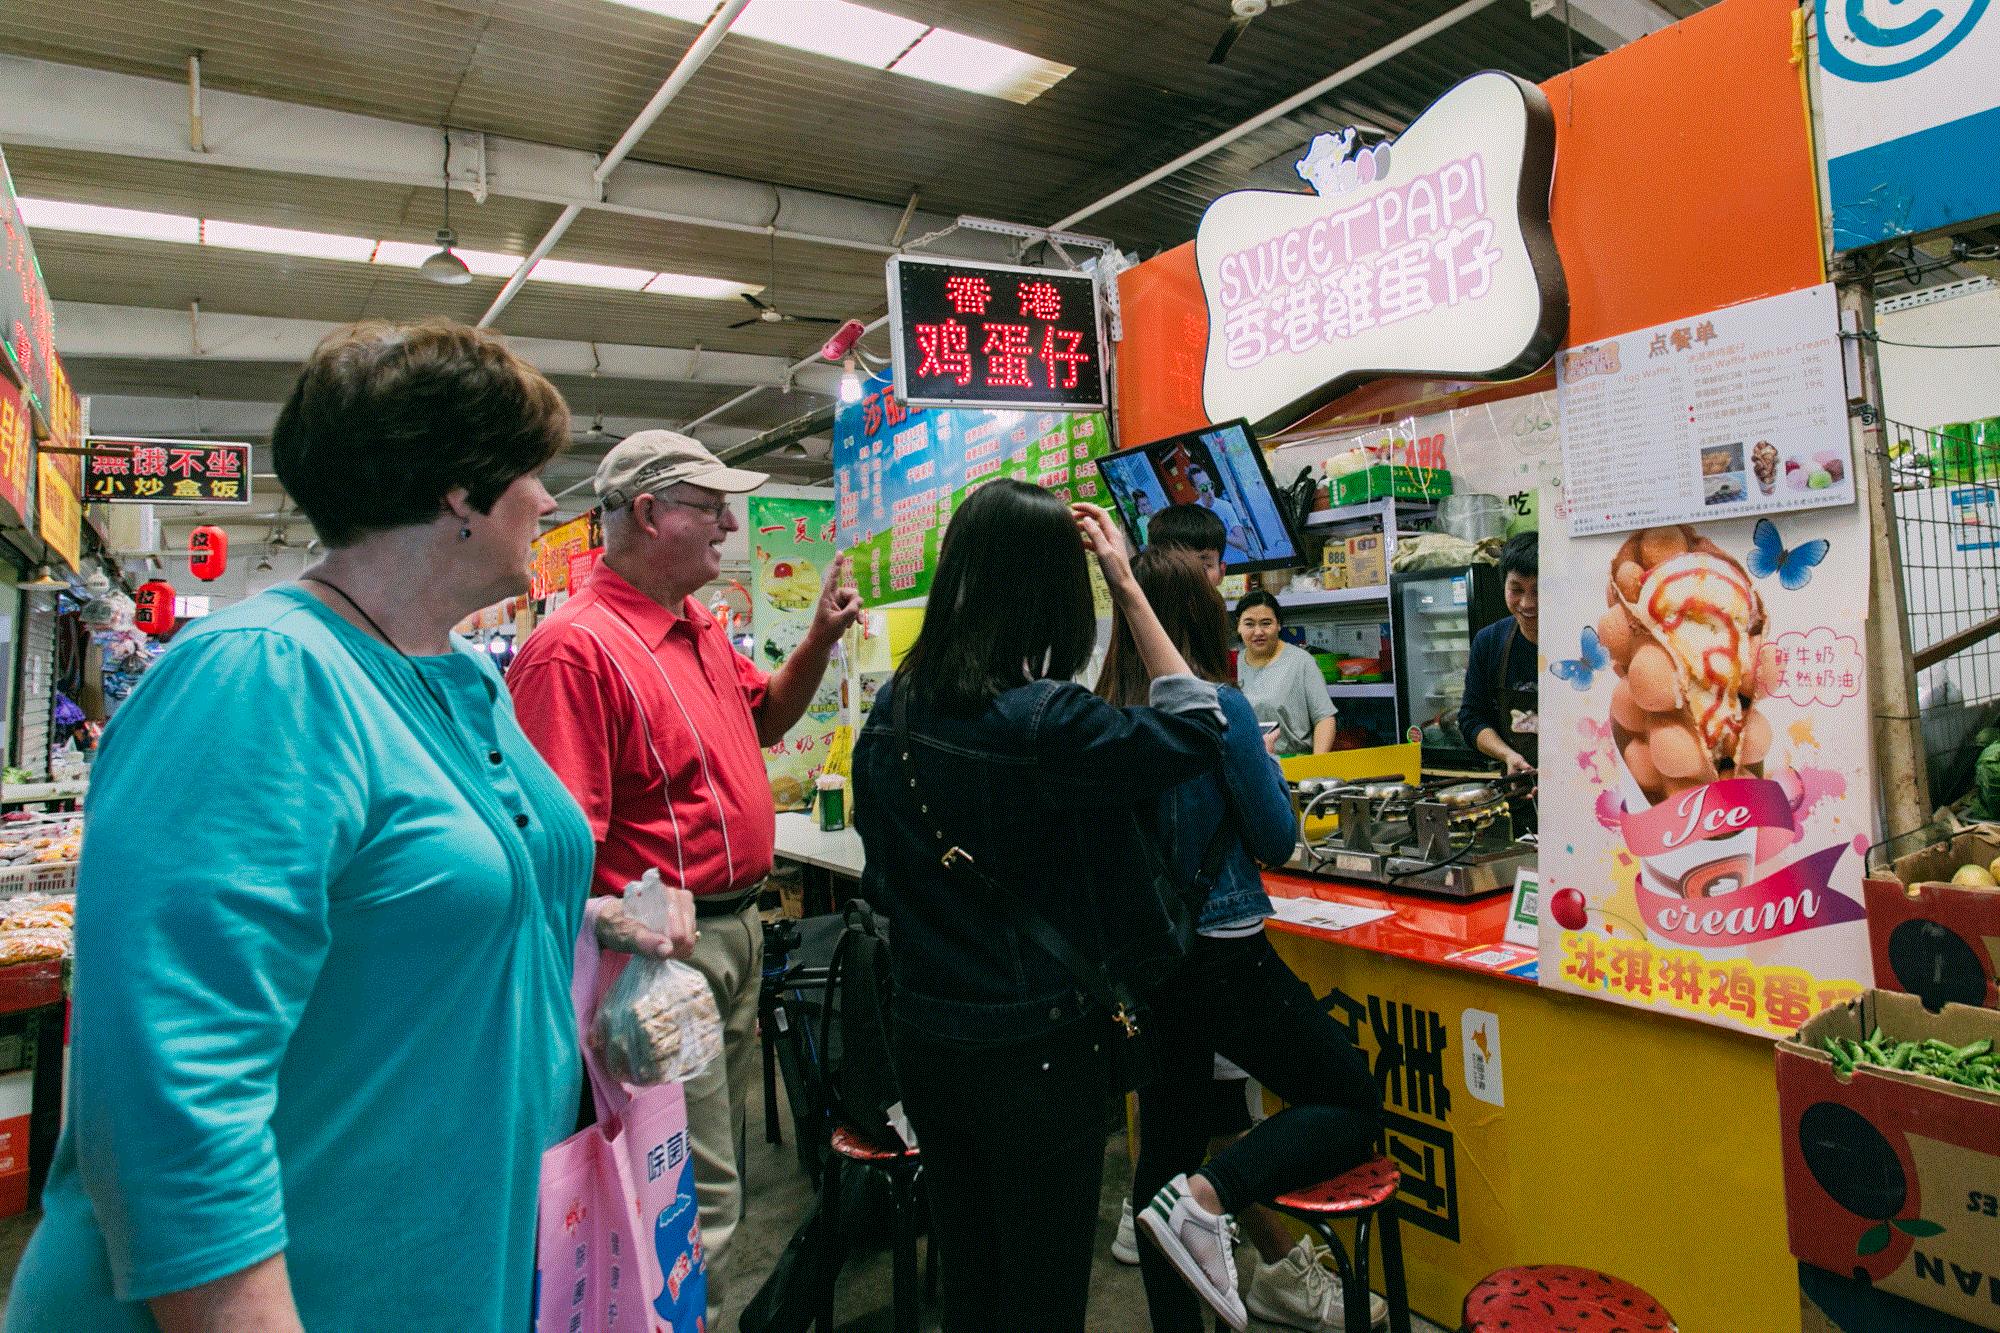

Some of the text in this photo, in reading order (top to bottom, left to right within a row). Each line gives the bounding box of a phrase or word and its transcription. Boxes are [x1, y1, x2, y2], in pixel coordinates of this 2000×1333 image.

[1222, 157, 1485, 304] SWEET PAPI
[946, 276, 1063, 321] 香港
[1225, 221, 1502, 369] 香港雞蛋仔
[914, 317, 1090, 390] 鸡蛋仔
[1648, 321, 1719, 358] 点餐单
[1694, 336, 1830, 375] Egg Waffle With Ice Cream
[95, 476, 239, 497] 小炒盒饭
[1508, 491, 1531, 516] 吃
[1328, 551, 1345, 564] 888
[1775, 646, 1834, 666] 鲜牛奶
[1776, 668, 1854, 688] 天然奶油
[1662, 784, 1751, 848] Ice
[1656, 889, 1821, 936] cream
[646, 1125, 692, 1184] 除菌
